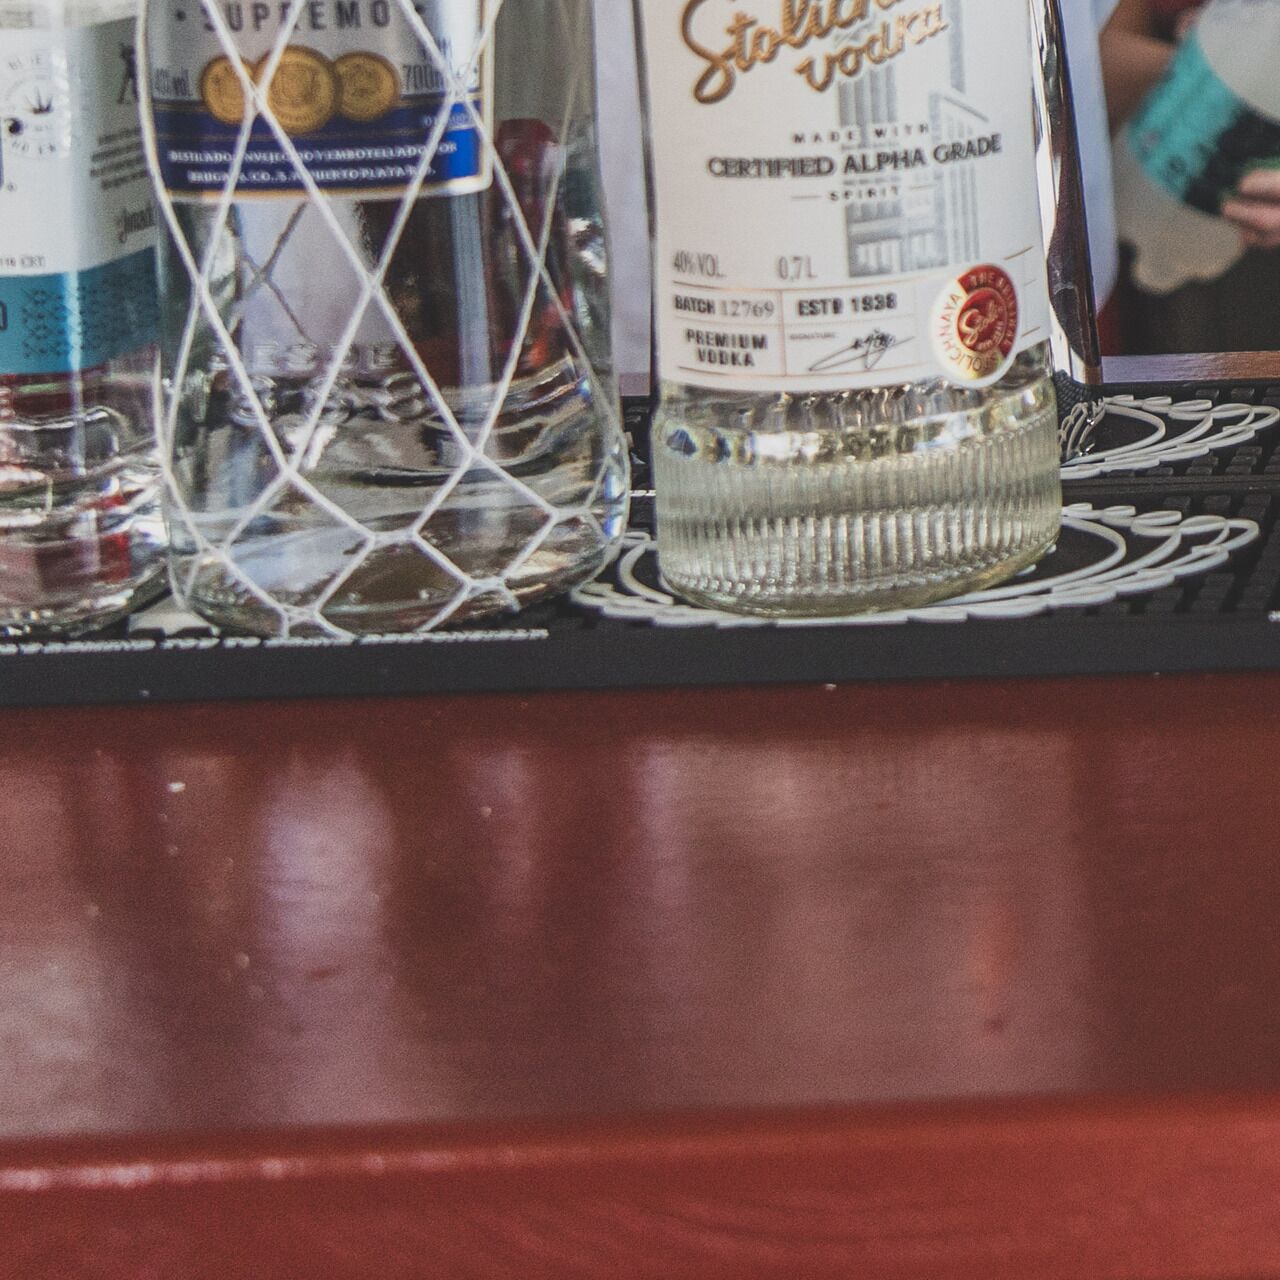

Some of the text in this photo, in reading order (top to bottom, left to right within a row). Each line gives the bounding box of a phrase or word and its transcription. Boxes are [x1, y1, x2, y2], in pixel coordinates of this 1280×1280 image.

[794, 3, 951, 93] vodka
[792, 121, 931, 144] MADE WITH
[706, 132, 1003, 179] CERTIFIED ALPHA GRADE
[828, 185, 901, 203] SPIRIT
[674, 293, 716, 315] BATCH
[720, 300, 775, 319] 12769
[850, 291, 899, 313] 1938
[685, 327, 769, 350] PREMIUM
[696, 348, 755, 367] VODKA
